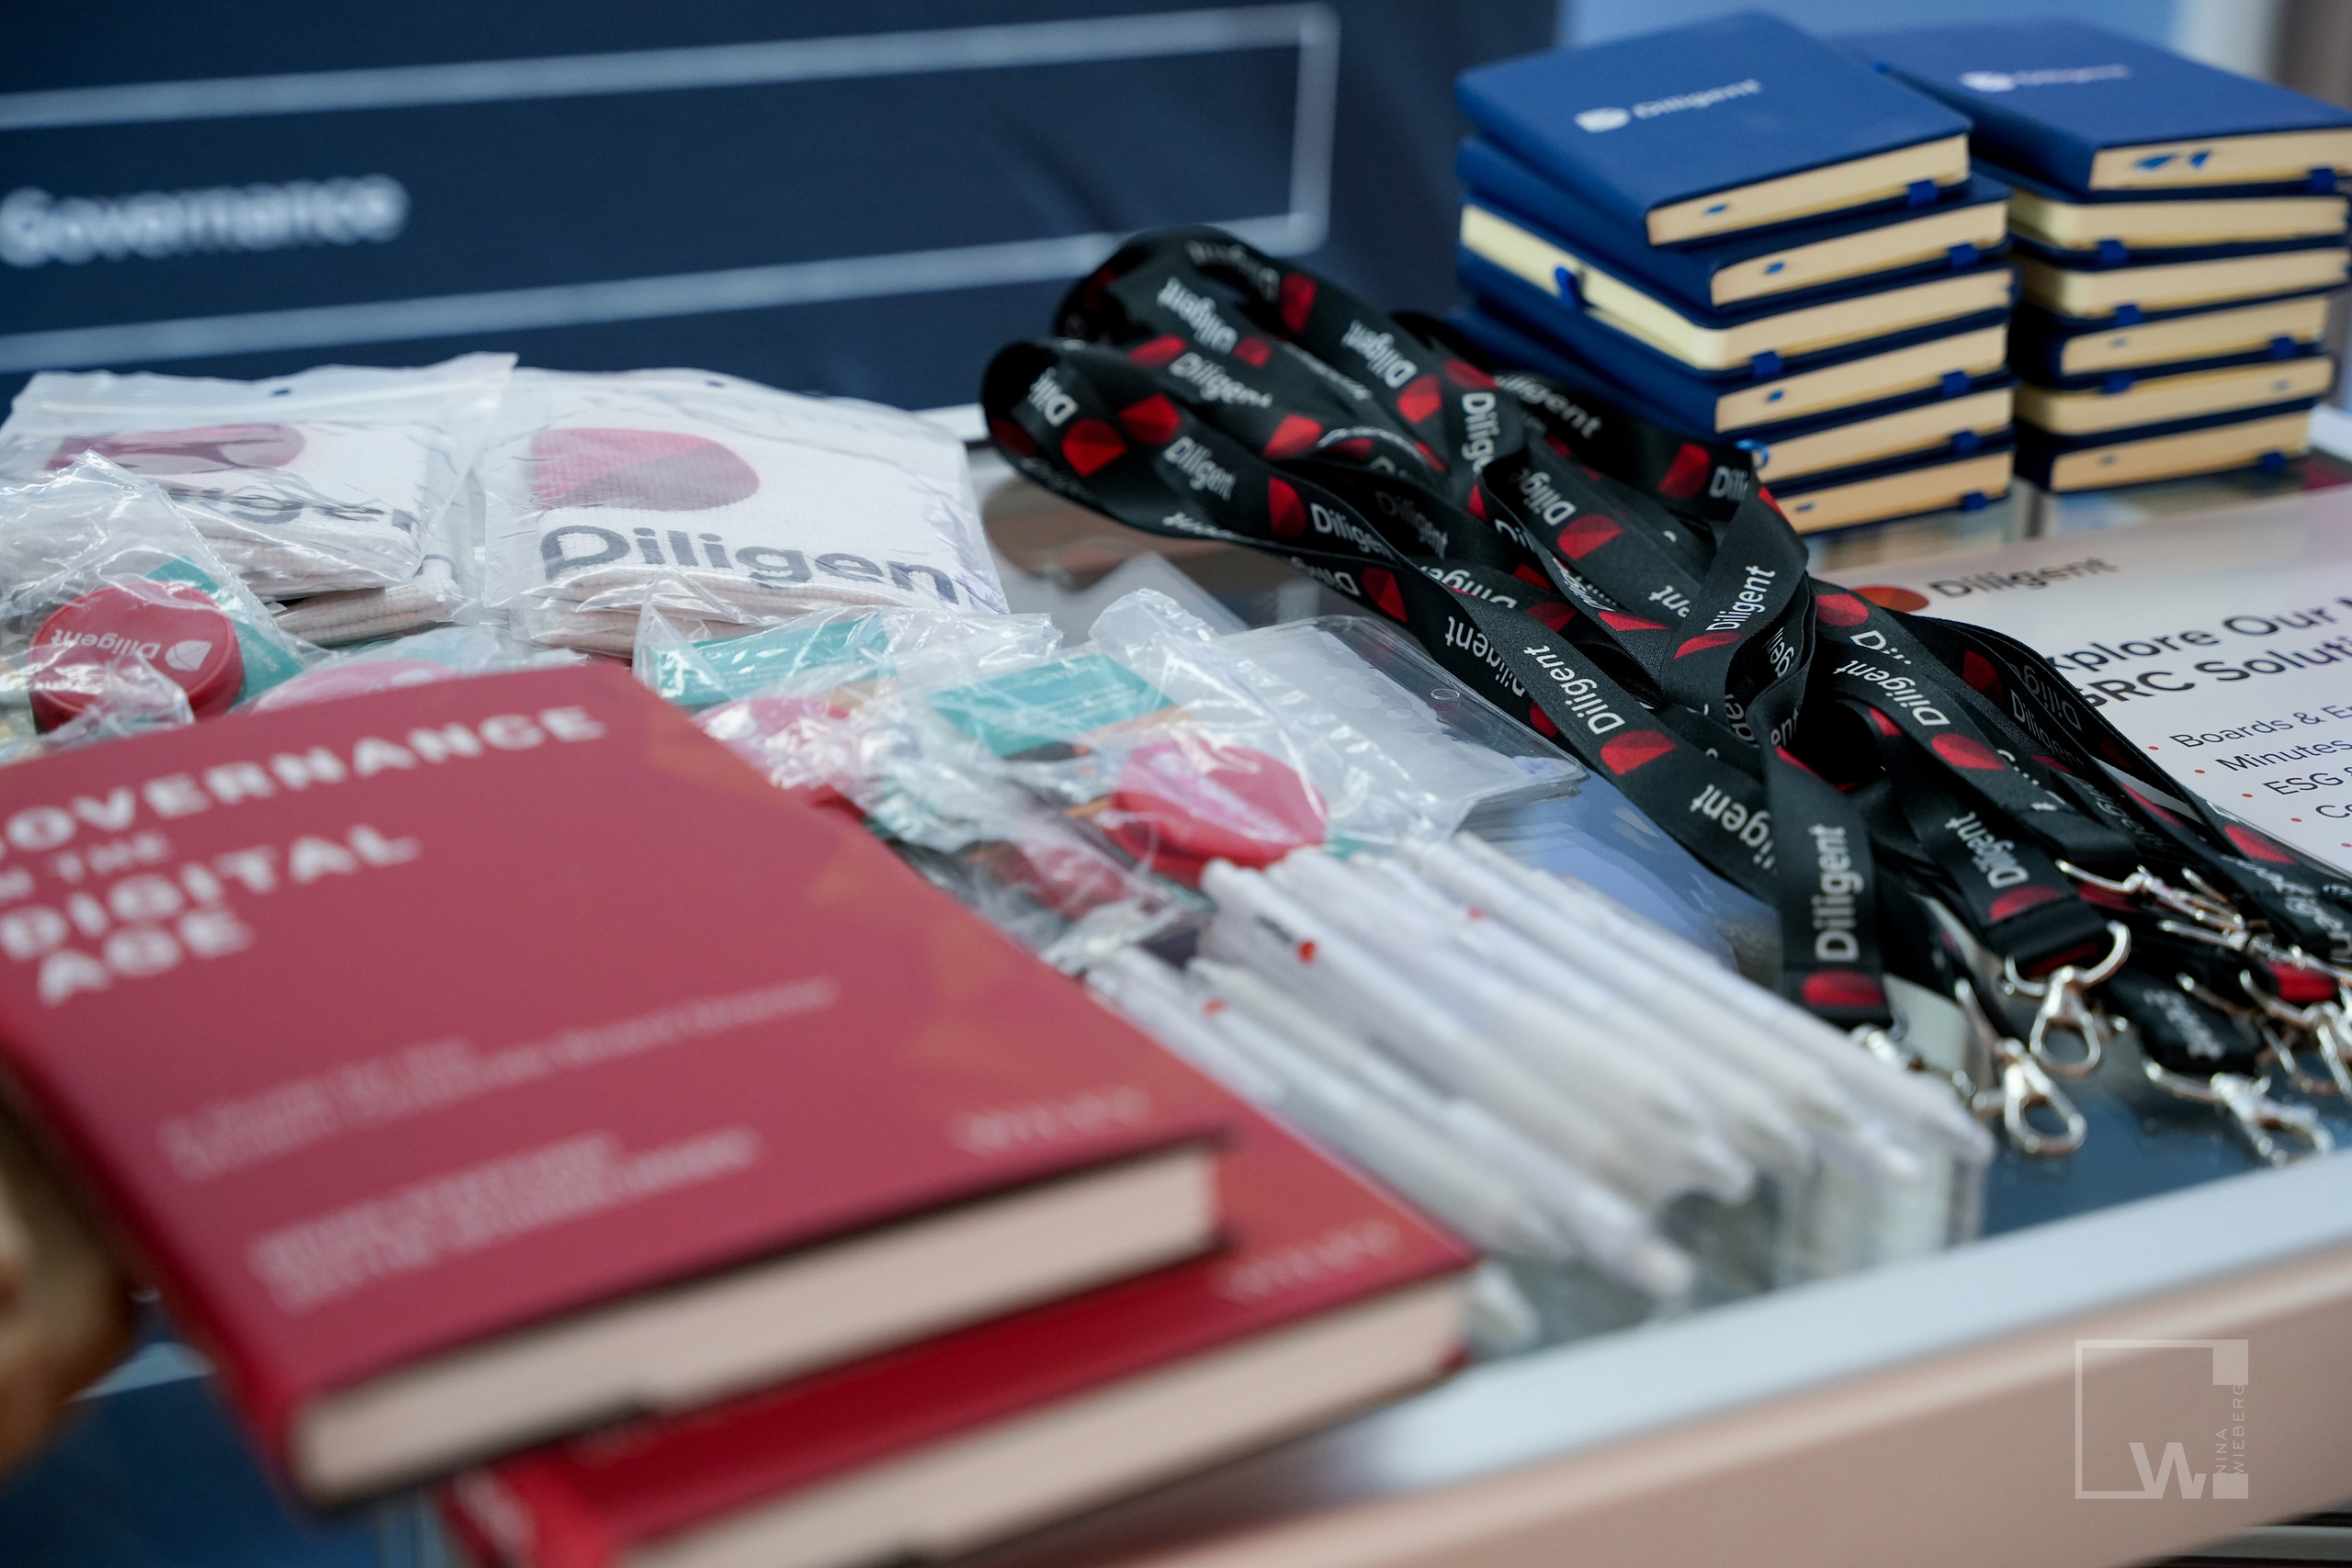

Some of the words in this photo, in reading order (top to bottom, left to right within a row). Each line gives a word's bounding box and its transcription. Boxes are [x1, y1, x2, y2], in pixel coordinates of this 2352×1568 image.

[1633, 79, 1761, 119] Diligent
[0, 175, 409, 267] Governance
[1170, 353, 1273, 409] Diligent
[1340, 320, 1419, 389] Diligent
[1706, 565, 1776, 631] Diligent
[1929, 557, 2115, 598] Diligent
[51, 628, 162, 660] Diligent
[2221, 606, 2337, 637] Our
[1523, 645, 1625, 735] Diligent
[1832, 659, 1951, 727] Diligent
[2168, 720, 2294, 748] Boards
[2292, 712, 2327, 725] &
[2215, 739, 2352, 772] Minutes
[0, 705, 606, 854] OVERNANCE
[2262, 773, 2345, 795] ESG
[1943, 811, 2030, 888] Diligent
[1807, 823, 1865, 962] Diligent
[38, 909, 254, 1008] AGE
